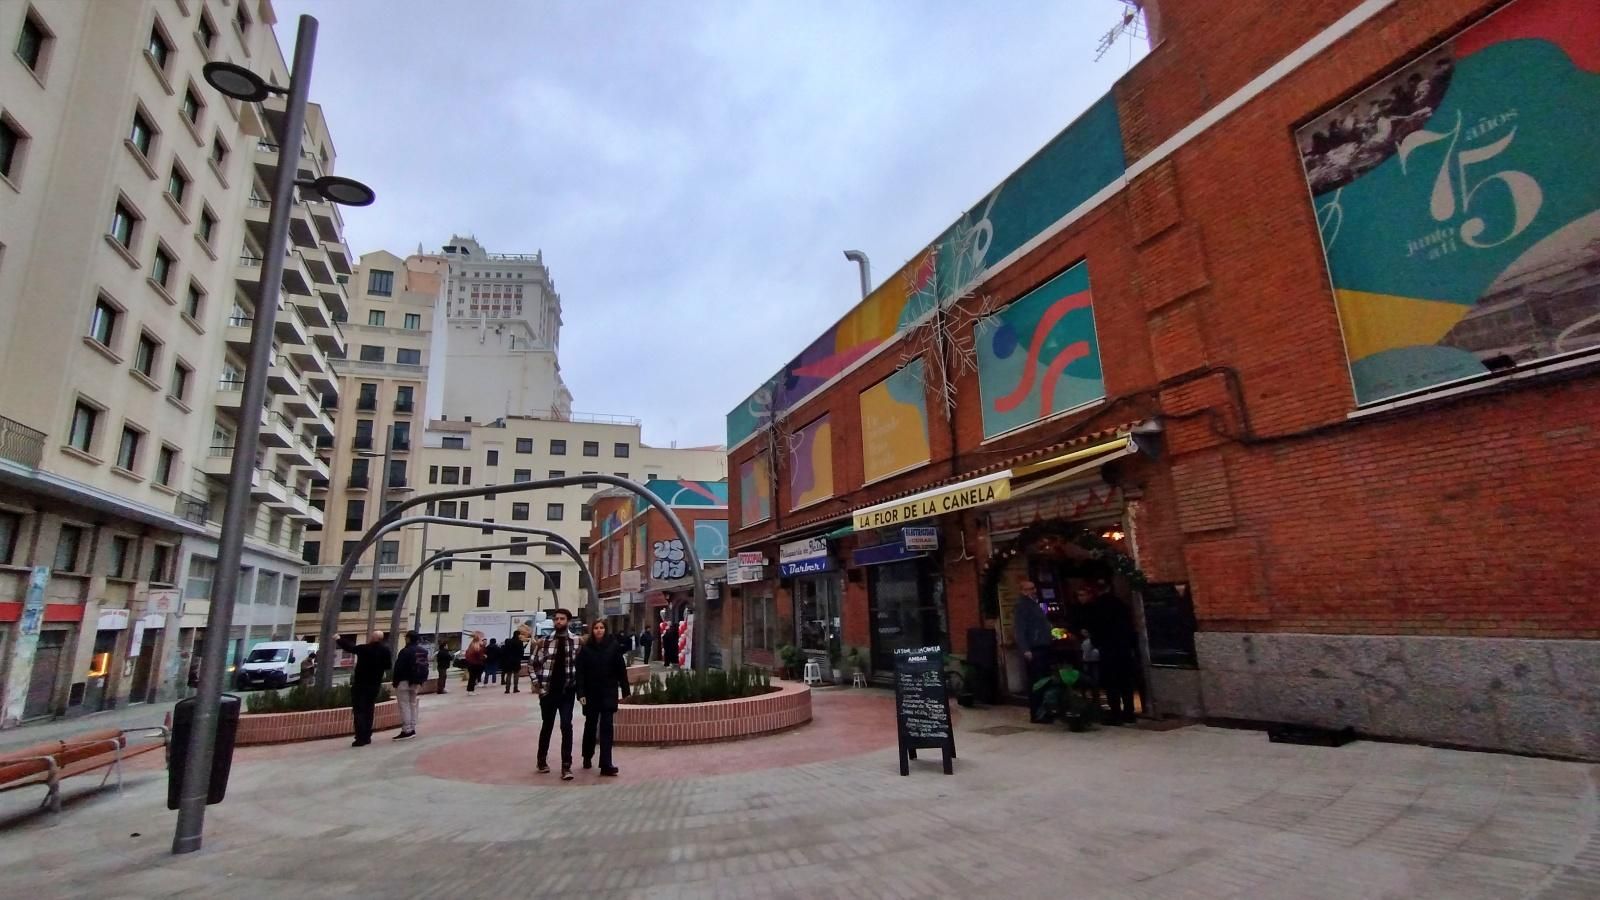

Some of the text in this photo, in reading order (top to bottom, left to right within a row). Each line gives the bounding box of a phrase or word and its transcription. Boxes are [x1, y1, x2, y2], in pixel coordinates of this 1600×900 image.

[1464, 108, 1519, 141] años
[1395, 108, 1544, 249] 75
[1405, 227, 1455, 257] junto
[860, 485, 996, 528] LA FLOR DE LA CANELA
[789, 561, 821, 575] Barber
